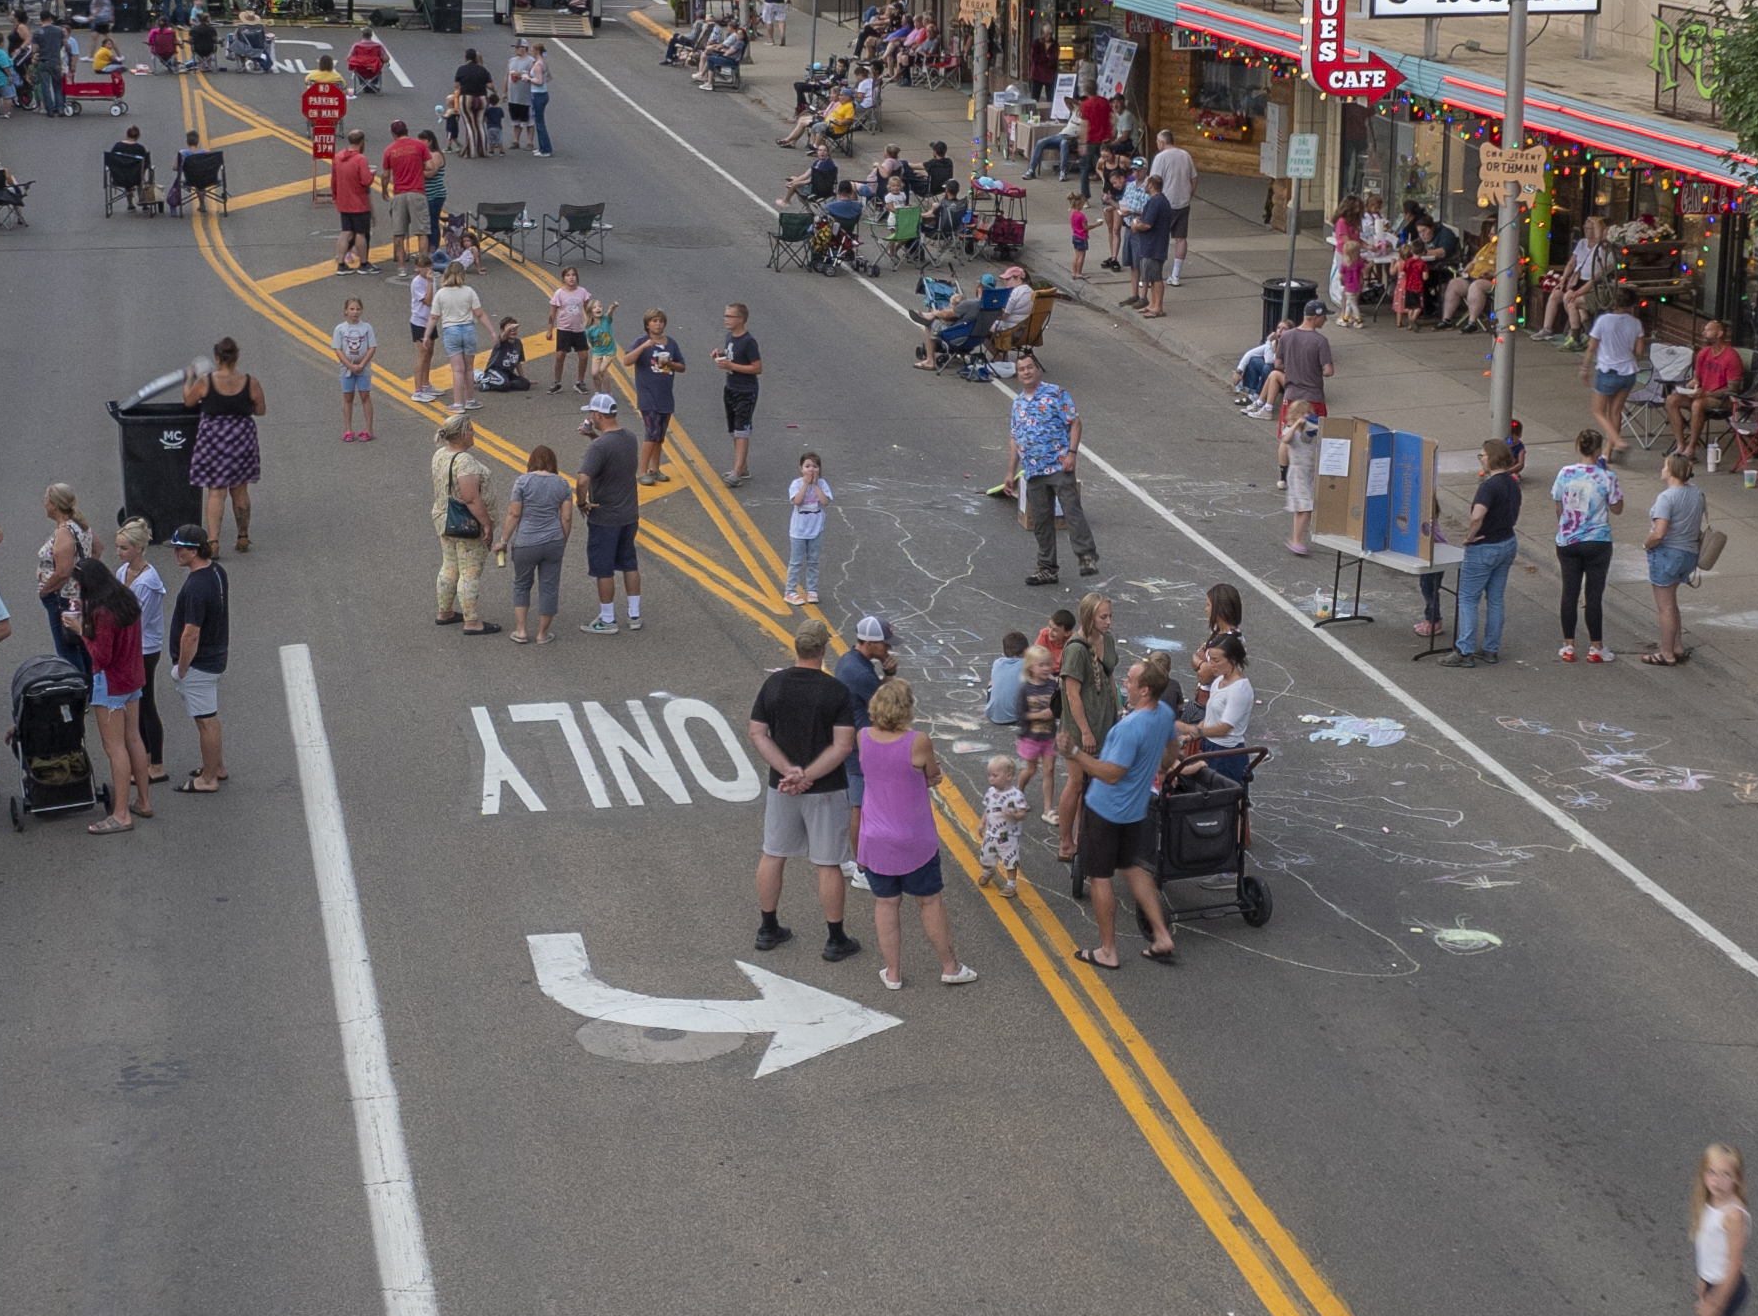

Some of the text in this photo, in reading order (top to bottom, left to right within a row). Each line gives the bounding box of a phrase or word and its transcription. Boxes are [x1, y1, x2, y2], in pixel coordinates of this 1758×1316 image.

[1328, 70, 1387, 90] CAFE
[318, 84, 330, 93] NO
[308, 96, 339, 106] PARKING
[308, 109, 339, 118] ON MAIN
[313, 134, 335, 143] AFTER
[1298, 138, 1309, 146] ONE
[1294, 148, 1311, 156] HOUR
[1509, 153, 1542, 161] JEREMY
[1290, 158, 1313, 166] PARKING
[1486, 162, 1538, 174] ORTHMAN
[470, 697, 761, 815] ONLY
